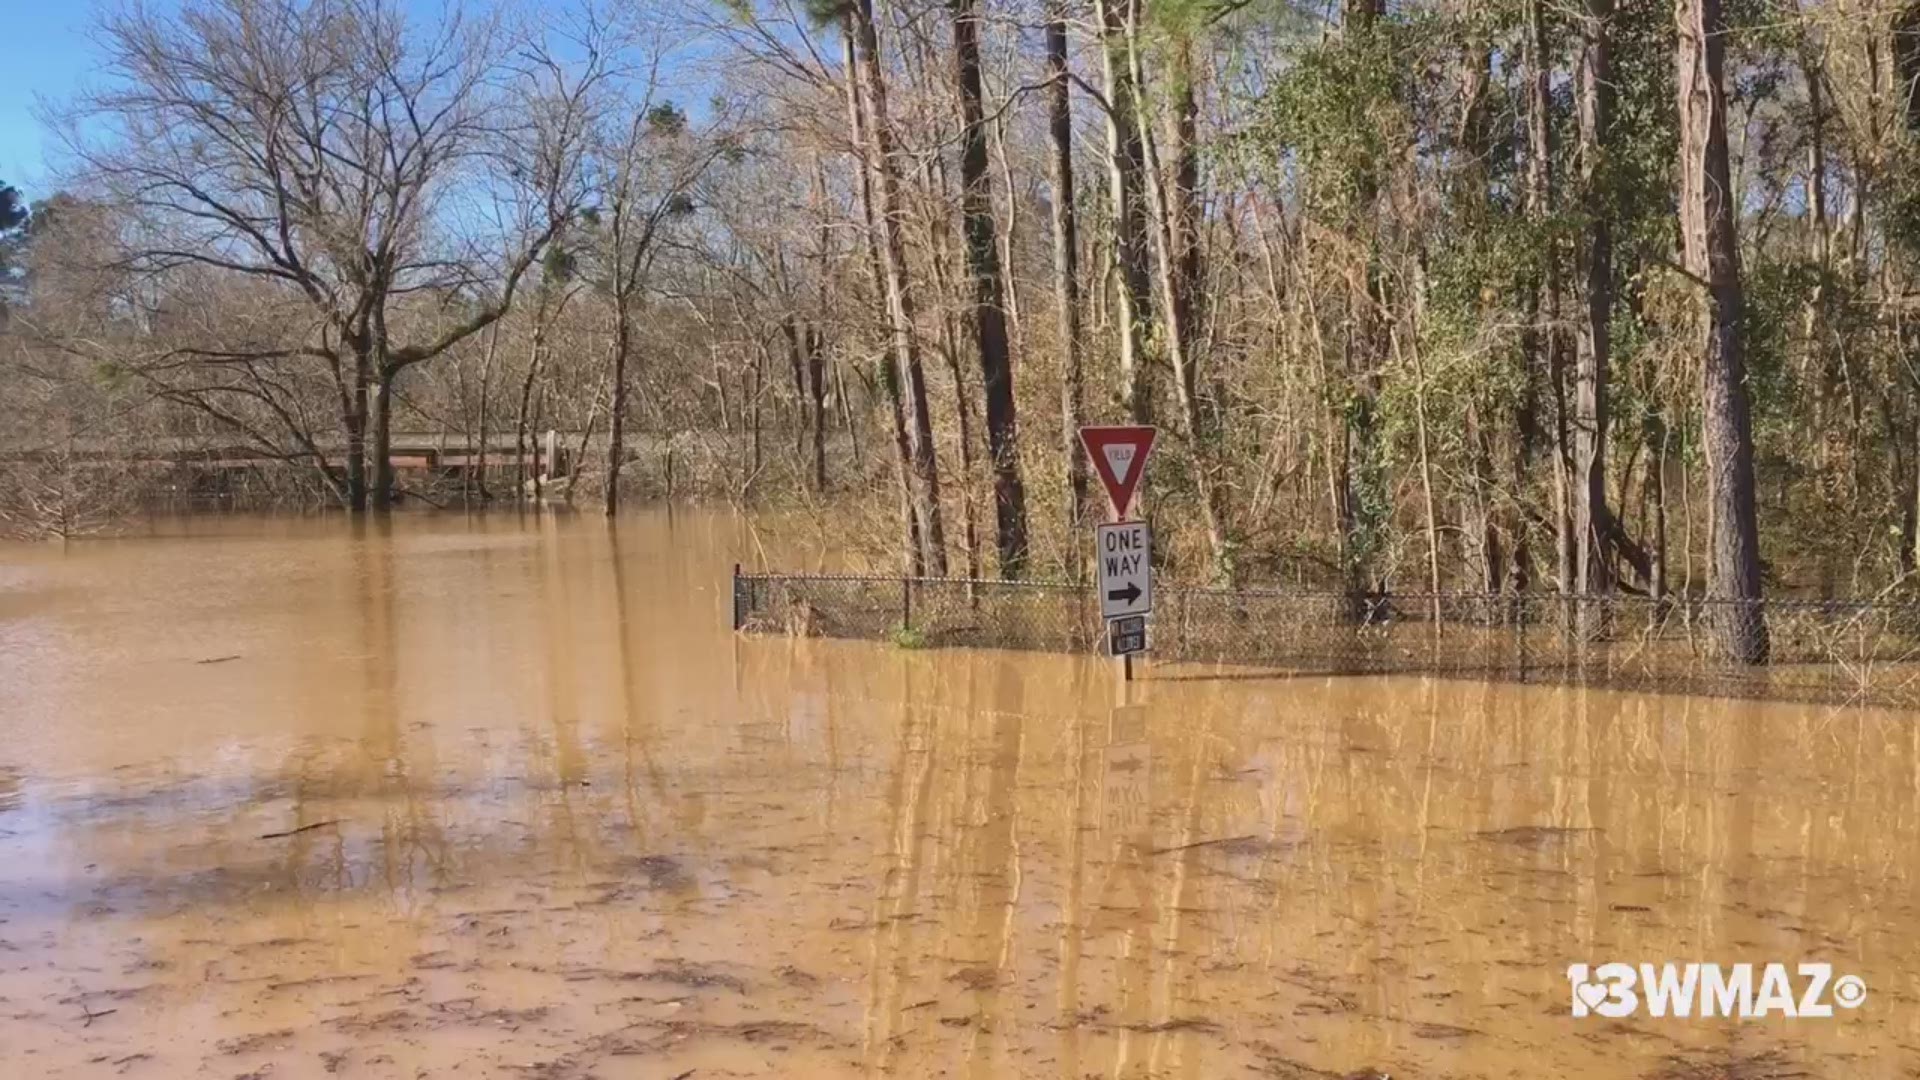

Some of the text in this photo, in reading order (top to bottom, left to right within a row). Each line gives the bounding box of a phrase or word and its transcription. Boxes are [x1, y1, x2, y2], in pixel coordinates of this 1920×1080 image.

[1108, 448, 1131, 460] YIELD
[1106, 529, 1142, 552] ONE
[1105, 554, 1142, 577] WAY
